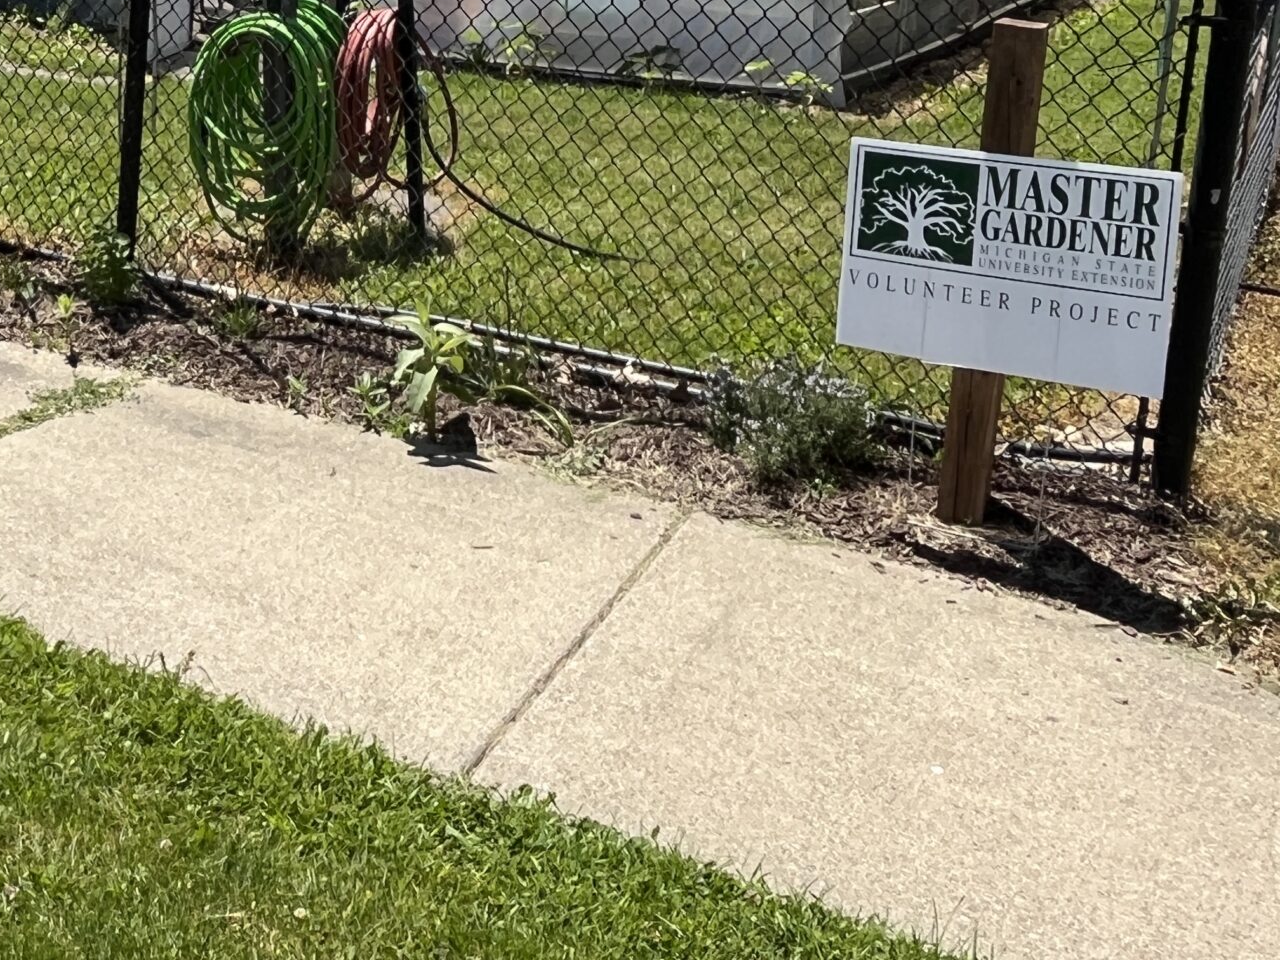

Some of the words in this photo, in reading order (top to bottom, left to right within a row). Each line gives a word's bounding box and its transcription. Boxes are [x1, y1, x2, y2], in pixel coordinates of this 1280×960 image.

[982, 166, 1160, 227] MASTER
[979, 244, 1080, 267] MICHIGAN
[1095, 258, 1157, 277] STATE
[980, 209, 1157, 262] GARDENER
[849, 269, 1010, 310] VOLUNTEER
[1031, 297, 1162, 332] PROJECT
[978, 257, 1064, 280] UNIVERSITY
[1071, 270, 1157, 291] EXTENSION
